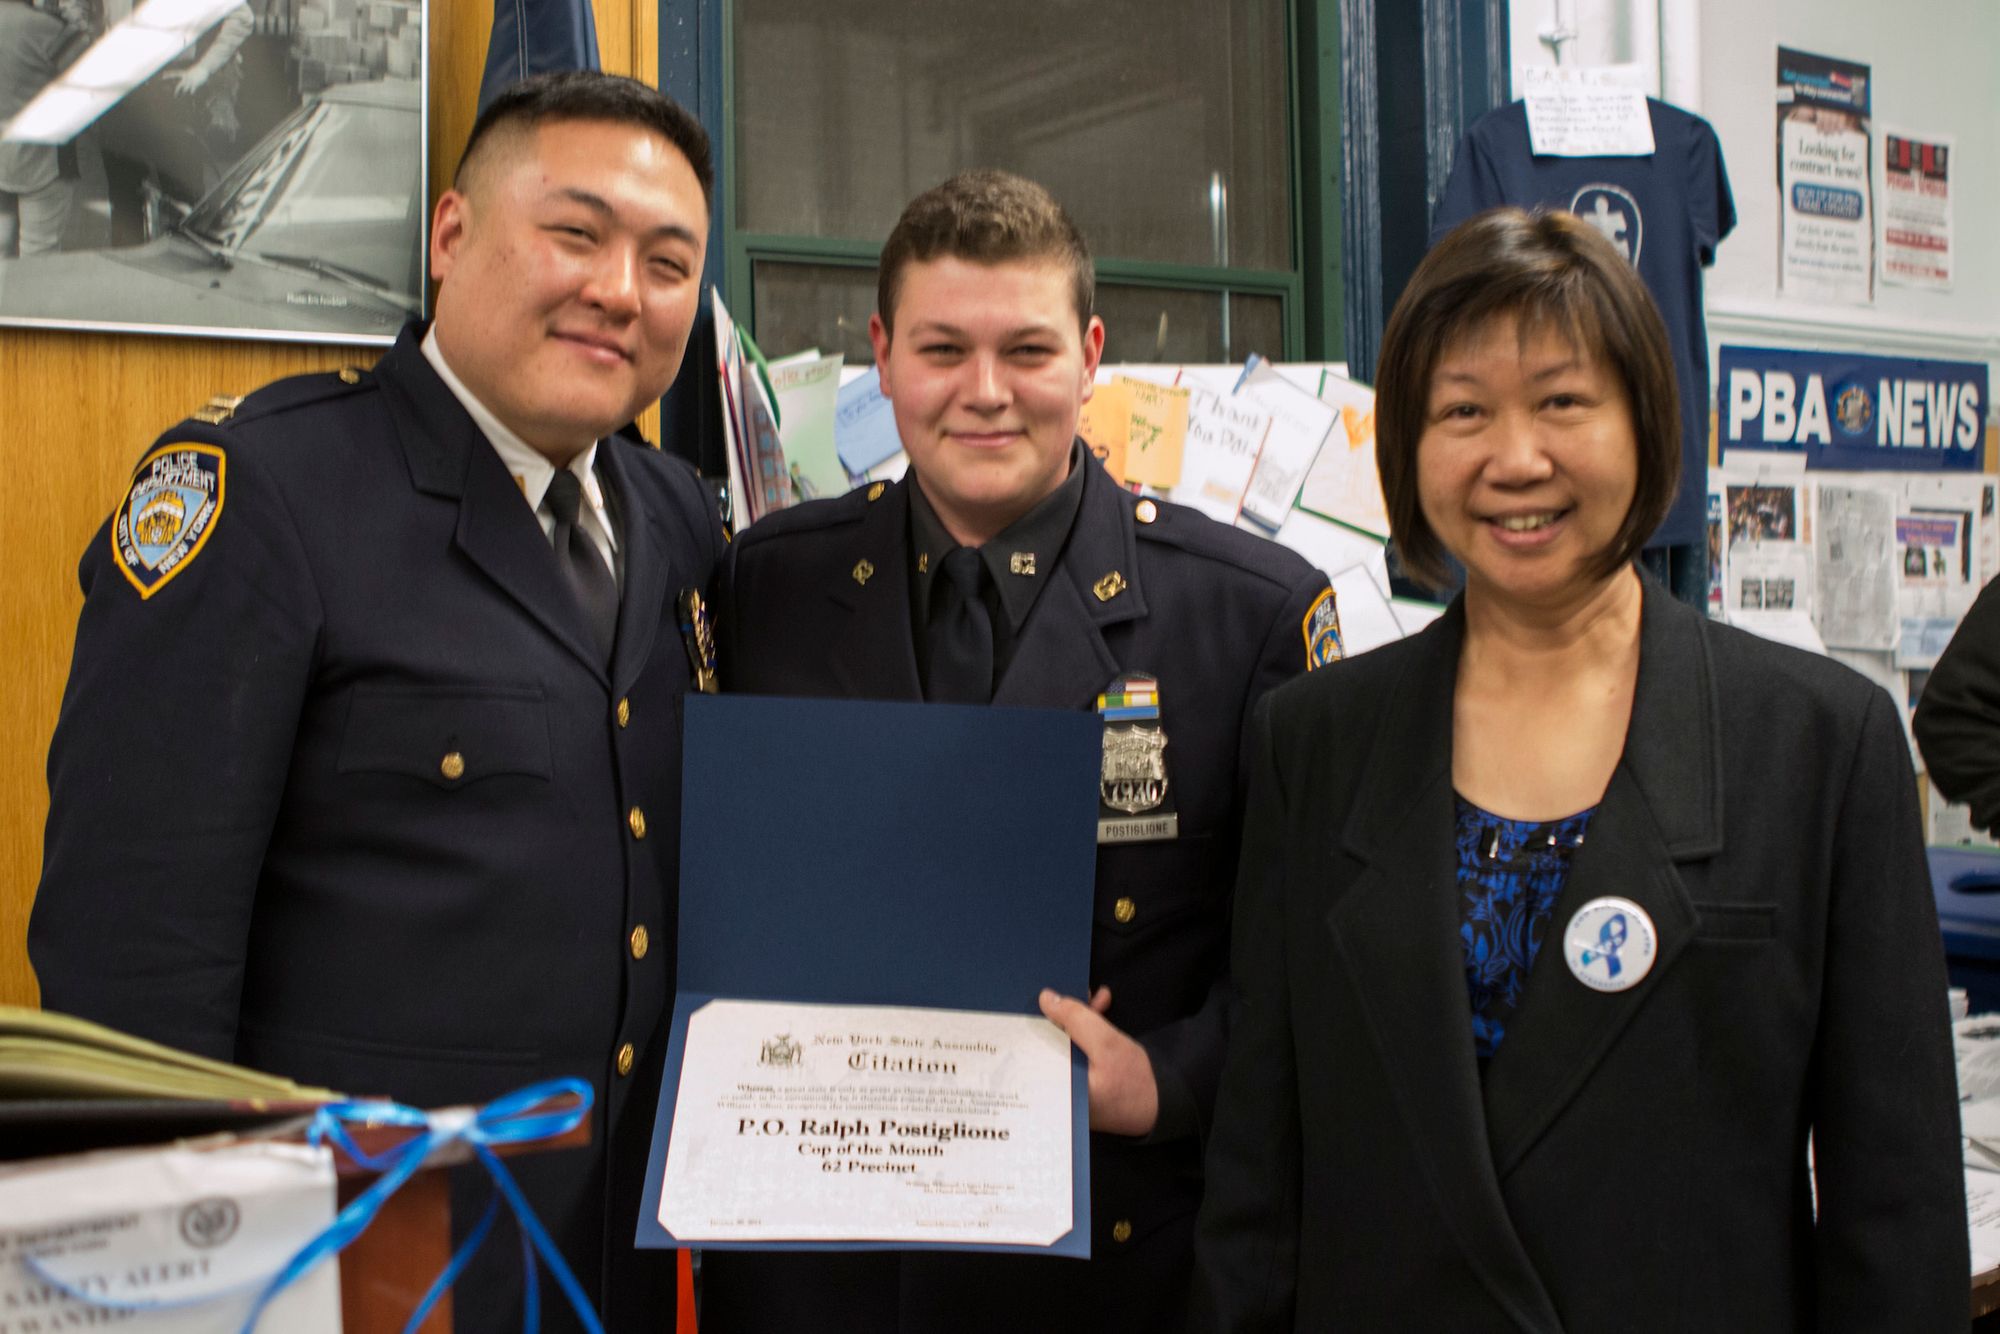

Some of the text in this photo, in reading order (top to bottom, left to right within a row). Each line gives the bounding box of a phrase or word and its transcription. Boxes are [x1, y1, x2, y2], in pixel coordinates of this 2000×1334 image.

[1799, 137, 1856, 161] Looking for
[1729, 368, 1980, 450] PBA NEWS
[152, 451, 198, 477] POLICE
[131, 469, 216, 501] DEPARTMENT
[157, 539, 189, 575] NEW
[185, 499, 217, 542] YORK
[1105, 822, 1168, 838] POSTIGLIONE
[813, 1035, 843, 1046] New
[849, 1034, 882, 1047] York
[889, 1036, 924, 1049] State
[848, 1050, 958, 1075] Citation
[737, 1117, 1010, 1143] P.O. Ralph Postiglione
[798, 1141, 944, 1158] Cop of the Month
[822, 1160, 917, 1174] 62 Precinct
